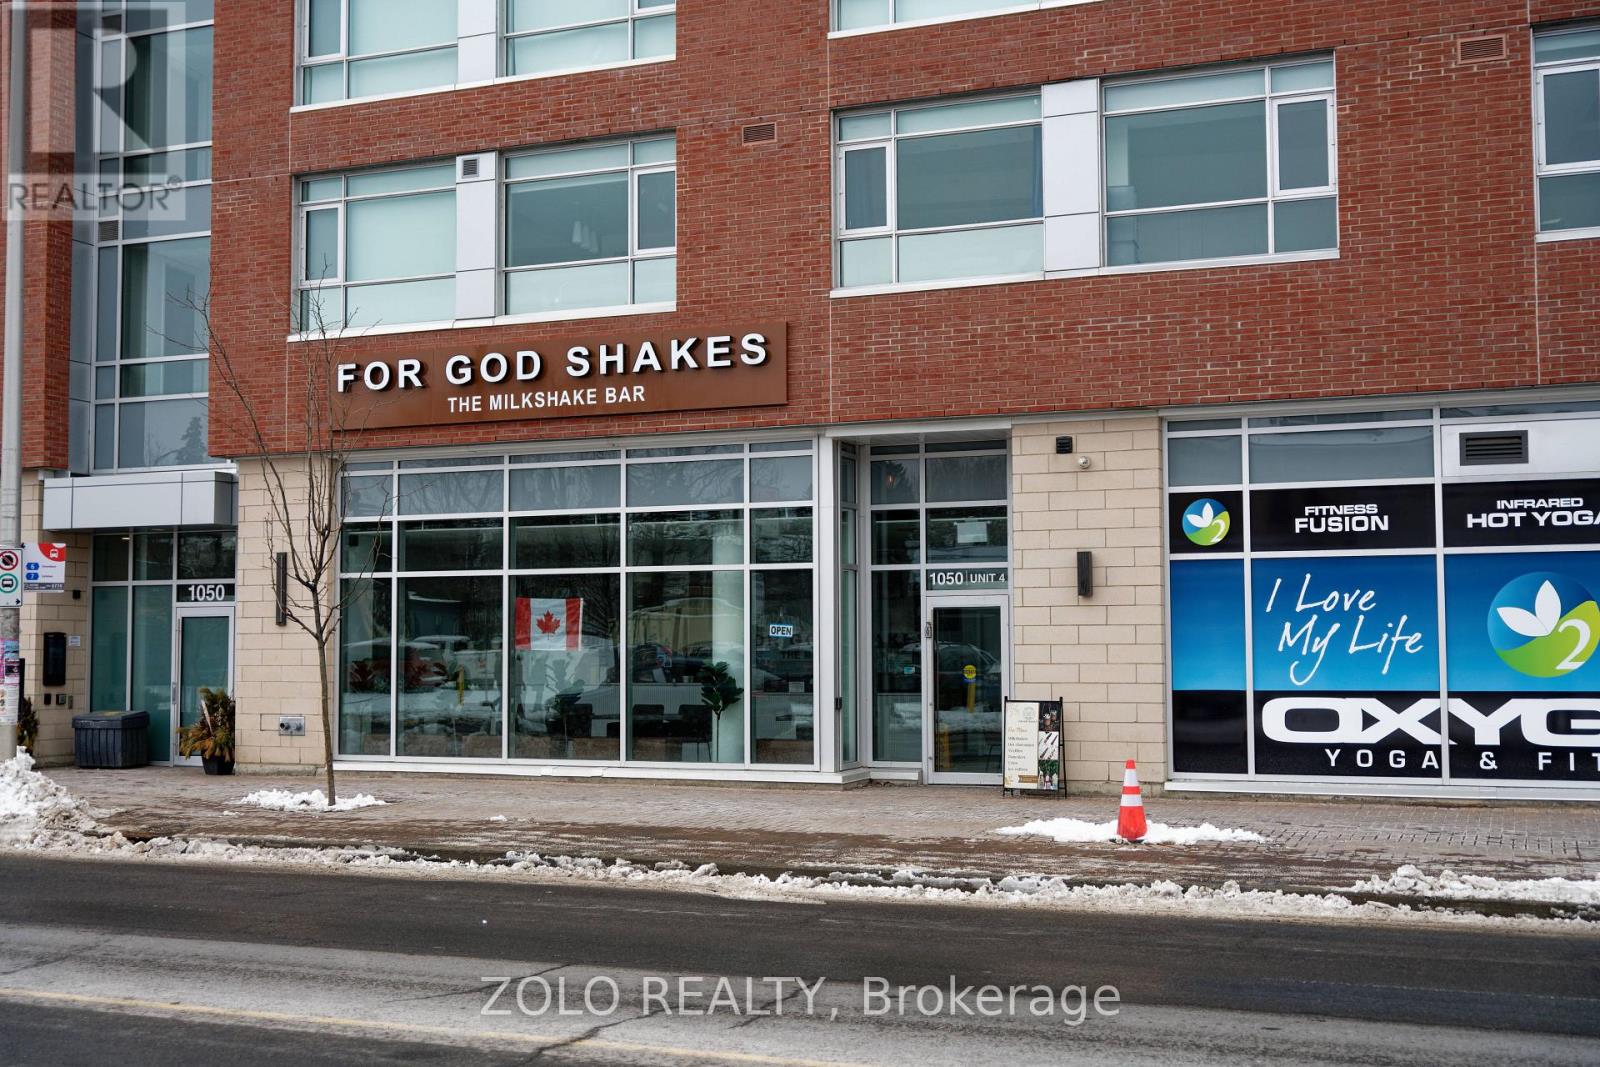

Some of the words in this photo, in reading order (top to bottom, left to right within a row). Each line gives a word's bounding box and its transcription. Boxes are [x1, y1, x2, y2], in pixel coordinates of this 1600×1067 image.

[337, 358, 424, 393] FOR
[445, 350, 542, 386] GOD
[566, 333, 767, 377] SHAKES
[448, 395, 482, 413] THE
[489, 387, 598, 411] MILKSHAKE
[605, 385, 646, 404] BAR
[1304, 503, 1379, 517] FITNESS
[1496, 497, 1584, 510] INFRARED
[1294, 515, 1389, 534] FUSION
[1466, 511, 1527, 528] HOT
[929, 571, 964, 586] 1050
[970, 573, 996, 584] UNIT
[998, 573, 1006, 583] 4
[188, 584, 226, 601] 1050
[1265, 577, 1283, 613] I
[1295, 572, 1377, 613] Love
[770, 625, 792, 636] OPEN
[1277, 614, 1341, 686] My
[1349, 614, 1425, 676] Life
[1262, 696, 1600, 747] OXYG
[1325, 748, 1440, 769] YOGA
[1479, 751, 1498, 770] &
